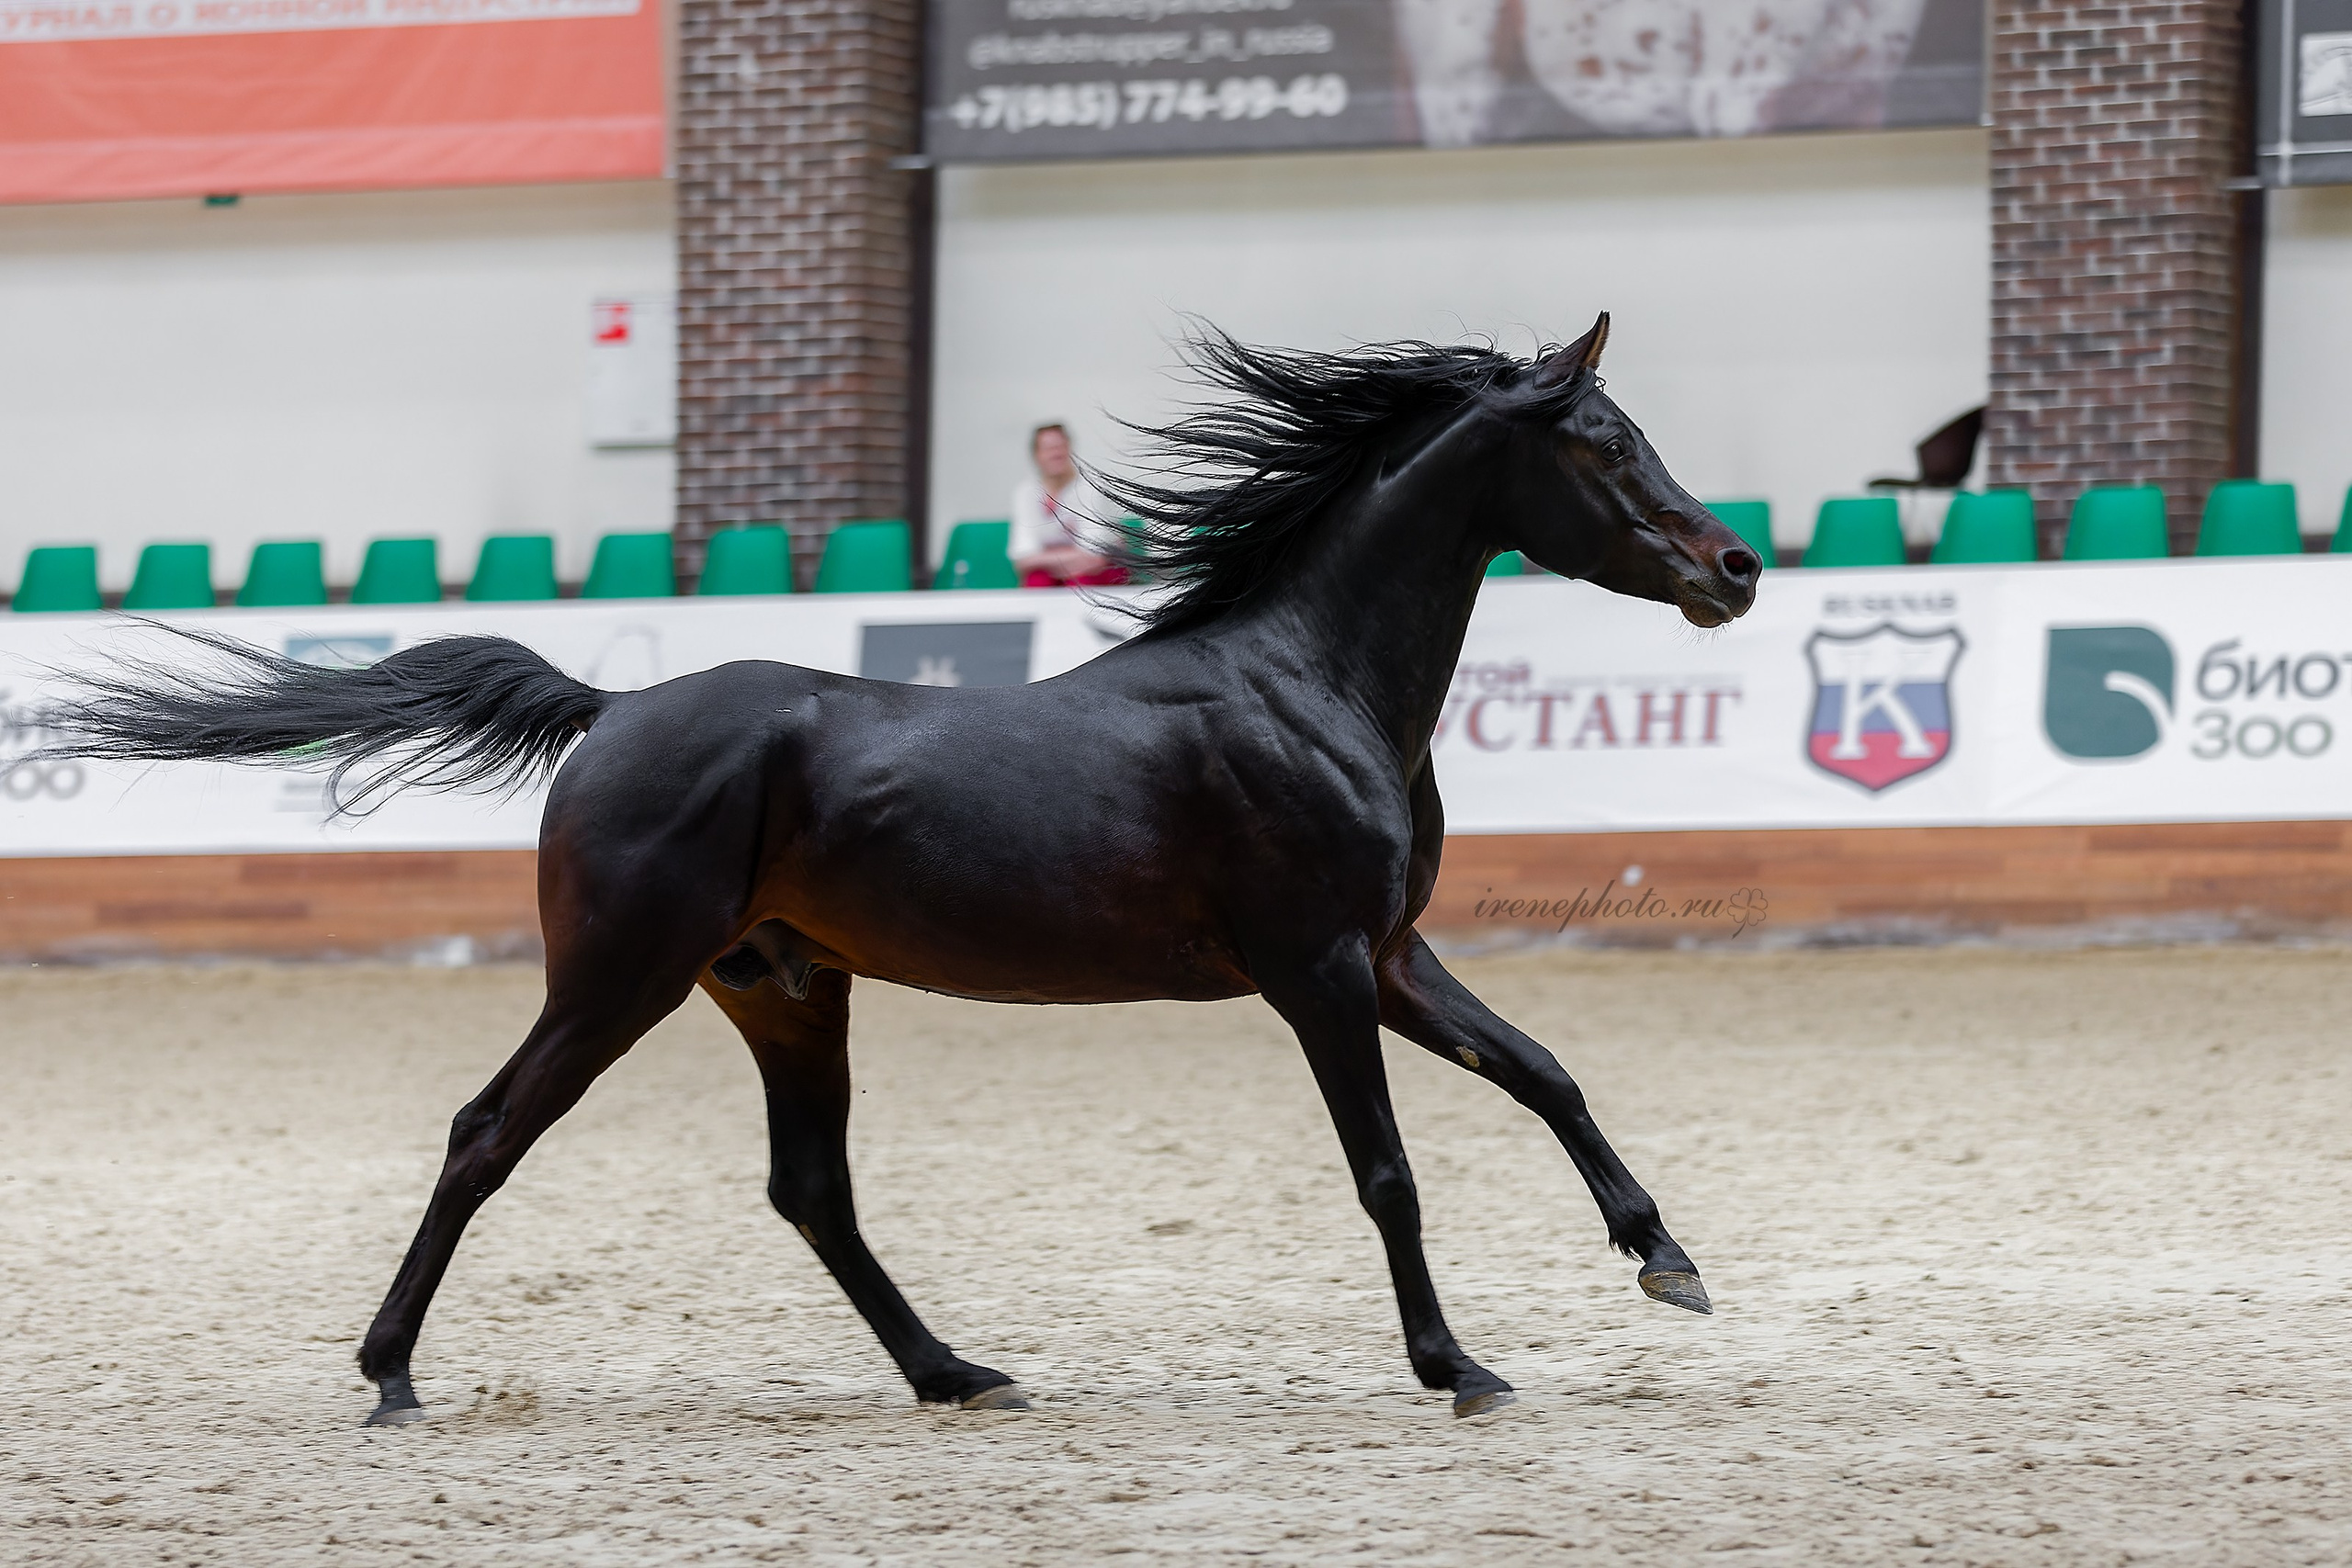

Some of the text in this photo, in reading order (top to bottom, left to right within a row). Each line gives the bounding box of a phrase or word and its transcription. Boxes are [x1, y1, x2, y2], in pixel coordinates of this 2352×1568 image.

[950, 73, 1348, 131] +7(985) 774-99-60
[2195, 637, 2352, 702] био
